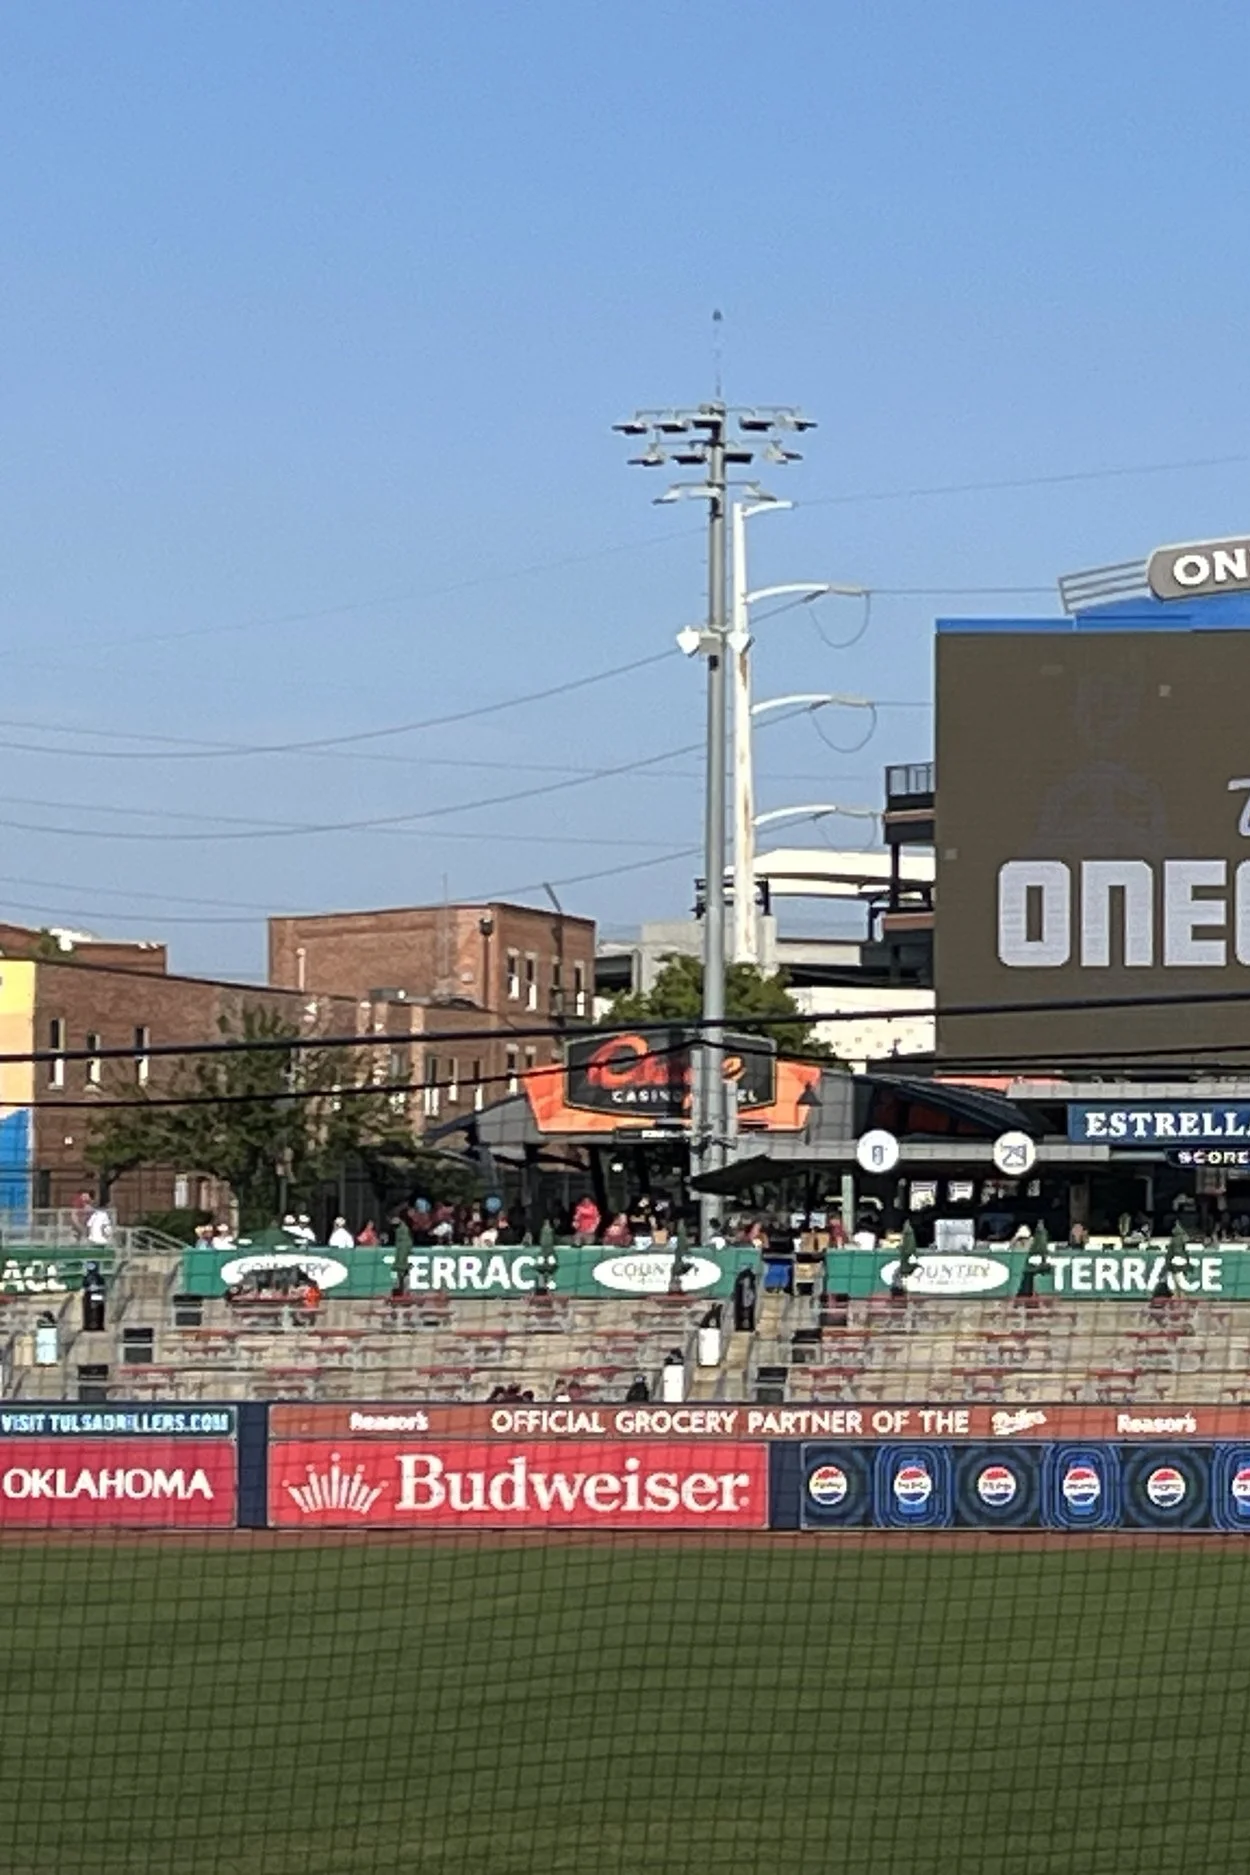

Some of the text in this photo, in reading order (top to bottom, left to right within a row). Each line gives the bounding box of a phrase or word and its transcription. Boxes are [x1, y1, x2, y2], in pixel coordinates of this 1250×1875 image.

[382, 1255, 557, 1290] ERRAC
[1046, 1255, 1222, 1292] TERRACE
[1, 1414, 229, 1432] VISIT TULSADRILLERS.COM
[491, 1410, 606, 1433] OFFICIAL
[615, 1410, 738, 1434] GROCERY
[748, 1411, 862, 1434] PARTNER
[871, 1410, 910, 1433] OF
[917, 1410, 969, 1434] THE
[1117, 1410, 1197, 1434] Reasor's
[2, 1467, 214, 1500] OKLAHOMA
[394, 1453, 749, 1512] Budweiser
